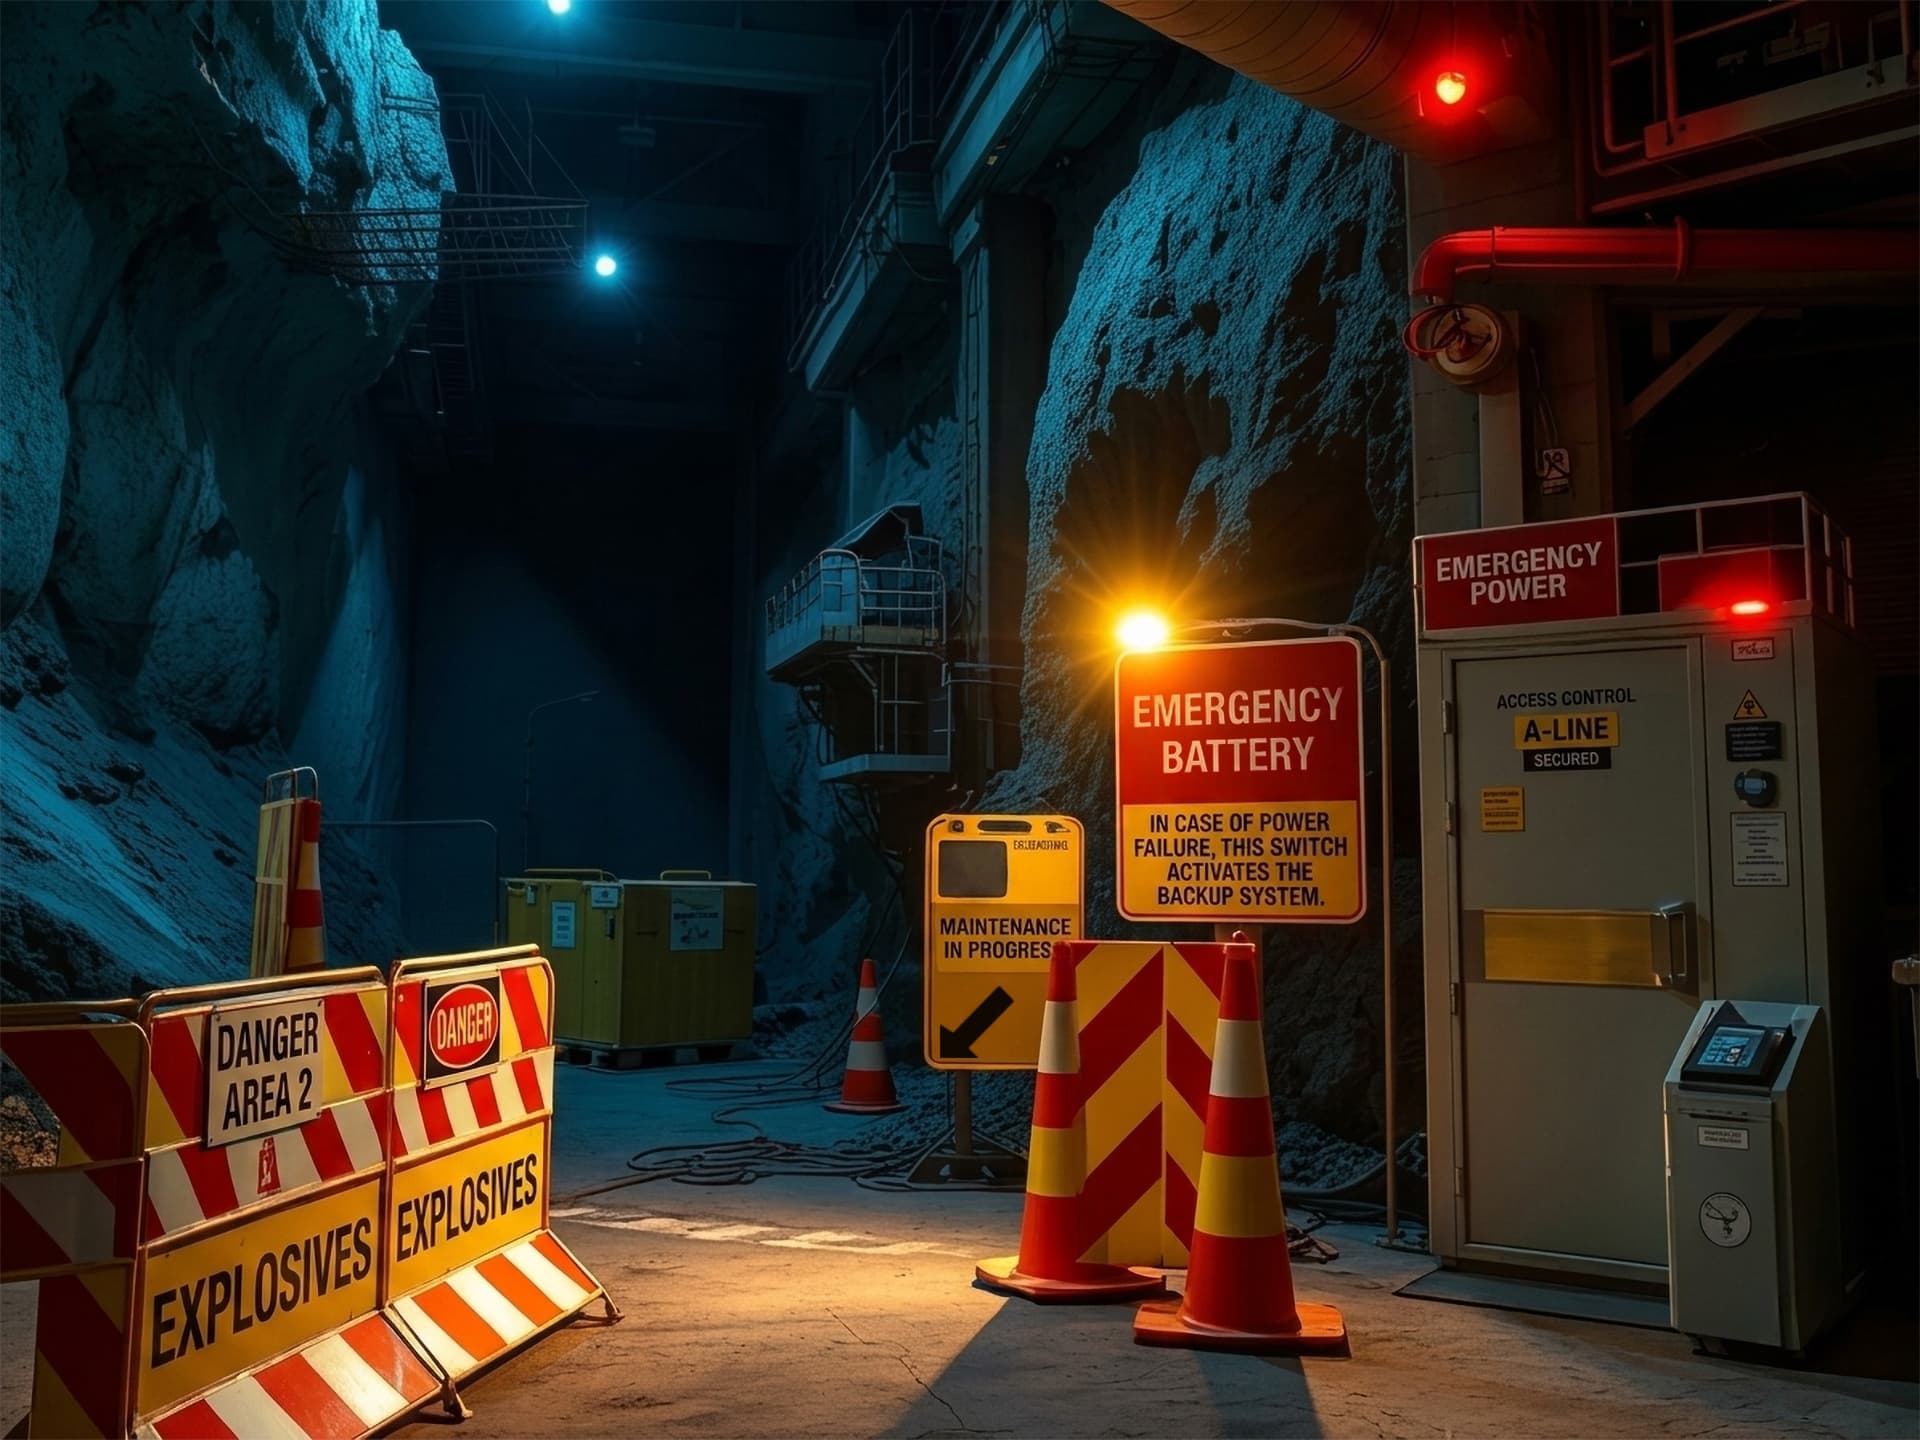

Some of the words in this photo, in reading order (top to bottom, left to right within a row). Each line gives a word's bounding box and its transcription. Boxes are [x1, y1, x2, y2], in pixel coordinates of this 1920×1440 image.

[1436, 541, 1602, 582] EMERGENCY
[1471, 574, 1567, 605] POWER
[1133, 687, 1344, 728] EMERGENCY
[1497, 692, 1558, 710] ACCESS
[1561, 687, 1637, 706] CONTROL
[1523, 717, 1609, 742] A-LINE
[1162, 736, 1315, 774] BATTERY
[1533, 751, 1600, 768] SECURED
[1150, 815, 1169, 833] IN
[1175, 814, 1224, 833] CASE
[1230, 813, 1254, 832] OF
[1260, 812, 1330, 832] POWER
[1134, 839, 1216, 860] FAILURE,
[1221, 837, 1264, 856] THIS
[1270, 837, 1348, 857] SWITCH
[1167, 862, 1270, 882] ACTIVATES
[1276, 862, 1313, 881] THE
[1157, 886, 1234, 905] BACKUP
[1240, 886, 1325, 906] SYSTEM.
[940, 918, 1072, 935] MAINTENANCE
[944, 941, 961, 959] IN
[968, 941, 1052, 959] PROGRES
[436, 1001, 493, 1050] DANGER
[217, 1011, 319, 1072] DANGER
[222, 1071, 292, 1131] AREA
[298, 1067, 313, 1112] 2
[396, 1153, 538, 1263] EXPLOSIVES
[151, 1217, 372, 1369] EXPLOSIVES
